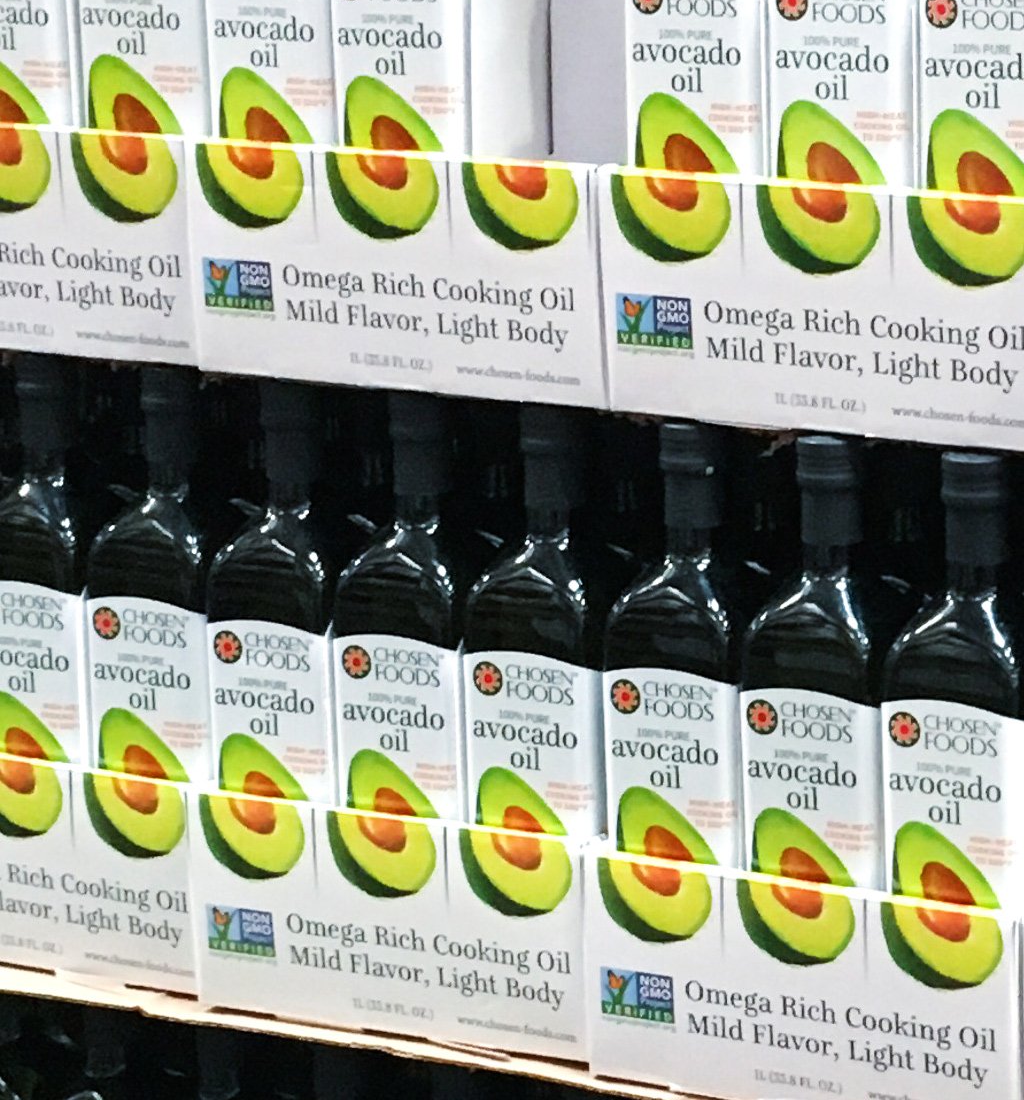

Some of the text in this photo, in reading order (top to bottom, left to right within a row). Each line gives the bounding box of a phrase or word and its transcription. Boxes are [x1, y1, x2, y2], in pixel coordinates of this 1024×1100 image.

[83, 4, 180, 30] avocado
[117, 31, 146, 55] oil
[338, 22, 442, 48] avocado
[633, 38, 741, 65] avocado
[375, 51, 405, 75] oil
[671, 67, 702, 92] oil
[966, 83, 1000, 109] oil
[0, 242, 182, 281] Rich Cooking Oil
[0, 280, 175, 317] avor, Light Body
[283, 265, 574, 316] Omega Rich Cooking Oil
[287, 300, 568, 353] Mild Flavor, Light Body
[704, 301, 794, 336] Omega
[804, 309, 860, 335] Rich
[870, 315, 980, 355] Cooking
[707, 337, 1018, 394] Mild Flavor, Light Body
[506, 681, 574, 706] FOODS
[473, 716, 577, 751] avocado
[782, 719, 852, 743] FOODS
[510, 746, 540, 770] oil
[748, 760, 856, 788] avocado
[787, 787, 818, 810] oil
[7, 863, 188, 913] Rich Cooking Oil
[0, 890, 182, 948] lavor, Light Body
[286, 913, 570, 974] Omega Rich Cooking Oil
[290, 945, 564, 1011] Mild Flavor, Light Body
[685, 981, 995, 1052] Omega Rich Cooking Oil
[689, 1013, 987, 1089] Mild Flavor, Light Body
